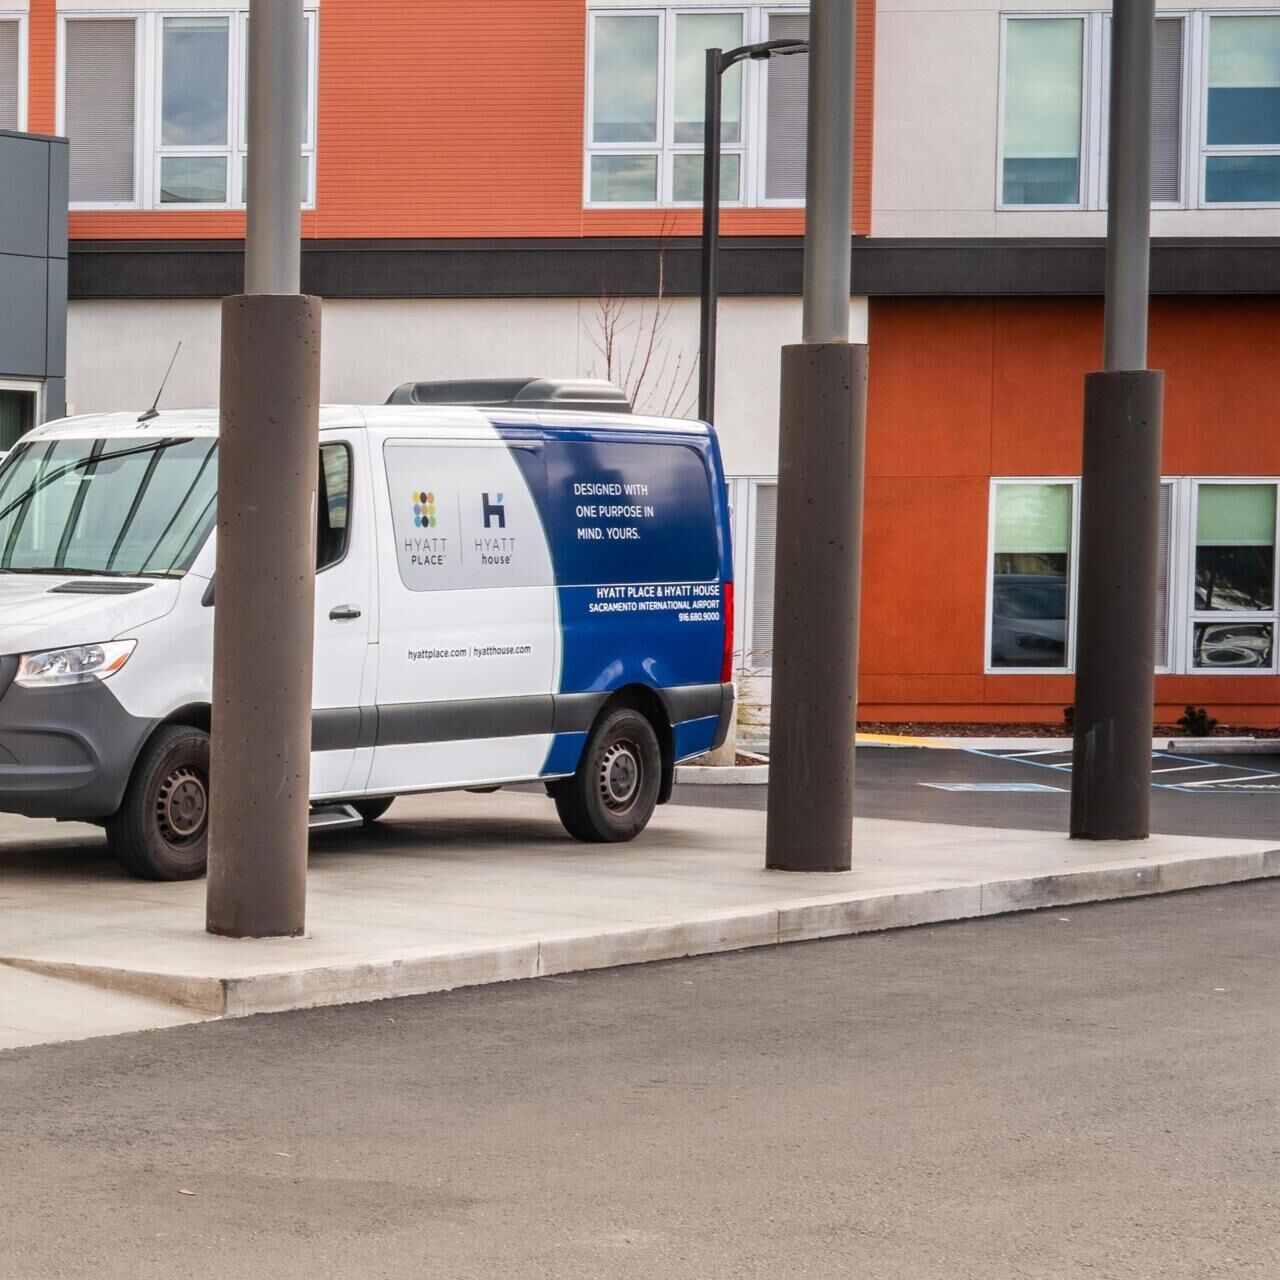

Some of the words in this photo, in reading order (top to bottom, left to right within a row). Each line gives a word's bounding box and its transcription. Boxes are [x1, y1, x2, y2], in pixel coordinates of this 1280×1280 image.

[573, 483, 622, 496] DESIGNED
[623, 483, 649, 496] WITH
[576, 505, 597, 518] ONE
[598, 505, 642, 518] PURPOSE
[643, 505, 654, 518] IN
[577, 527, 605, 540] MIND.
[606, 527, 641, 540] YOURS.
[404, 537, 448, 552] HYATT
[474, 537, 516, 551] HYATT
[411, 554, 444, 566] PLACE
[481, 553, 511, 565] house
[596, 586, 626, 599] HYATT
[627, 586, 655, 598] PLACE
[656, 586, 663, 597] &
[664, 585, 691, 597] HYATT
[692, 584, 720, 596] HOUSE
[589, 602, 638, 613] SACRAMENTO
[638, 600, 691, 611] INTERNATIONAL
[692, 599, 720, 609] AIRPORT
[407, 647, 467, 661] hyattplace.com
[473, 643, 531, 658] hyatthouse.com
